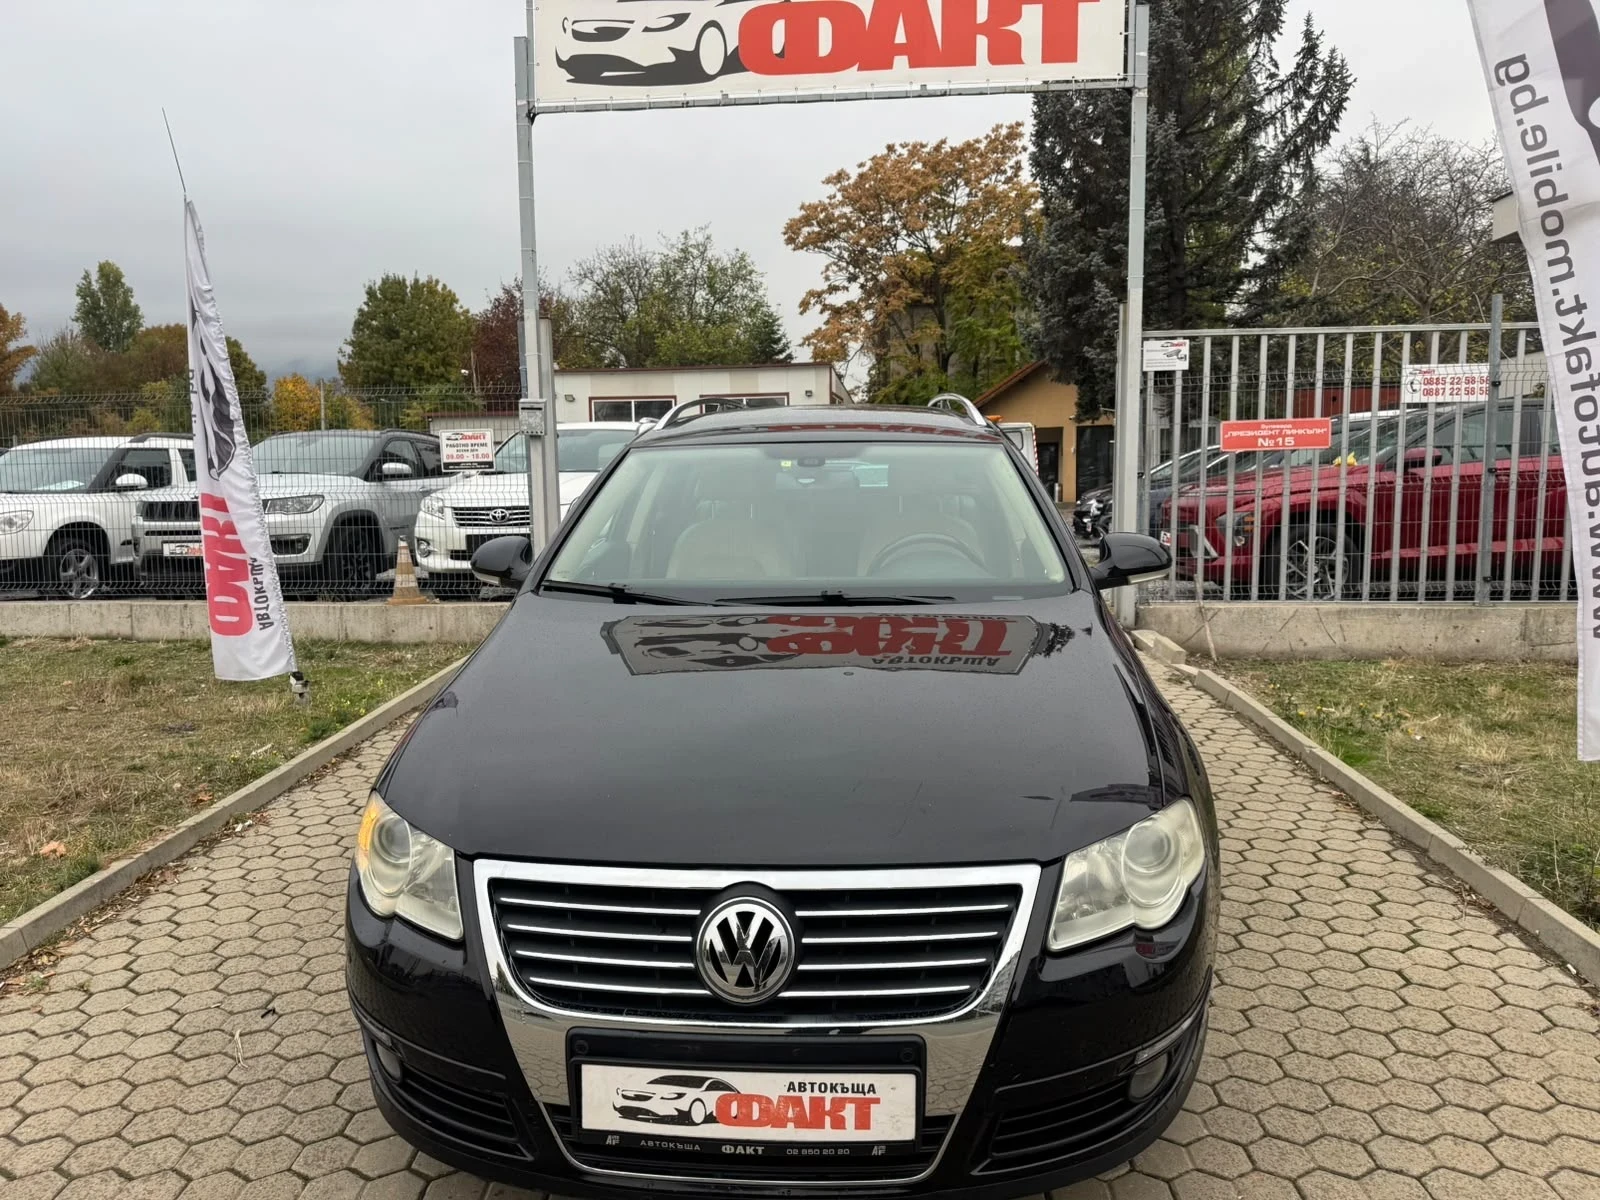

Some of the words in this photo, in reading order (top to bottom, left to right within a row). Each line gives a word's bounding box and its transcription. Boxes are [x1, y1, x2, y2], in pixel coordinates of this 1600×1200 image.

[738, 0, 1100, 75] ФАКТ
[1423, 377, 1446, 386] 0885
[1449, 377, 1461, 386] 22
[1464, 376, 1476, 385] 58
[1423, 387, 1446, 397] 0887
[1449, 387, 1461, 396] 22
[1464, 387, 1476, 396] 58
[786, 1080, 877, 1095] АВТОКЪЩА
[715, 1092, 881, 1130] ФАКТ
[721, 1144, 765, 1155] ФАКТ
